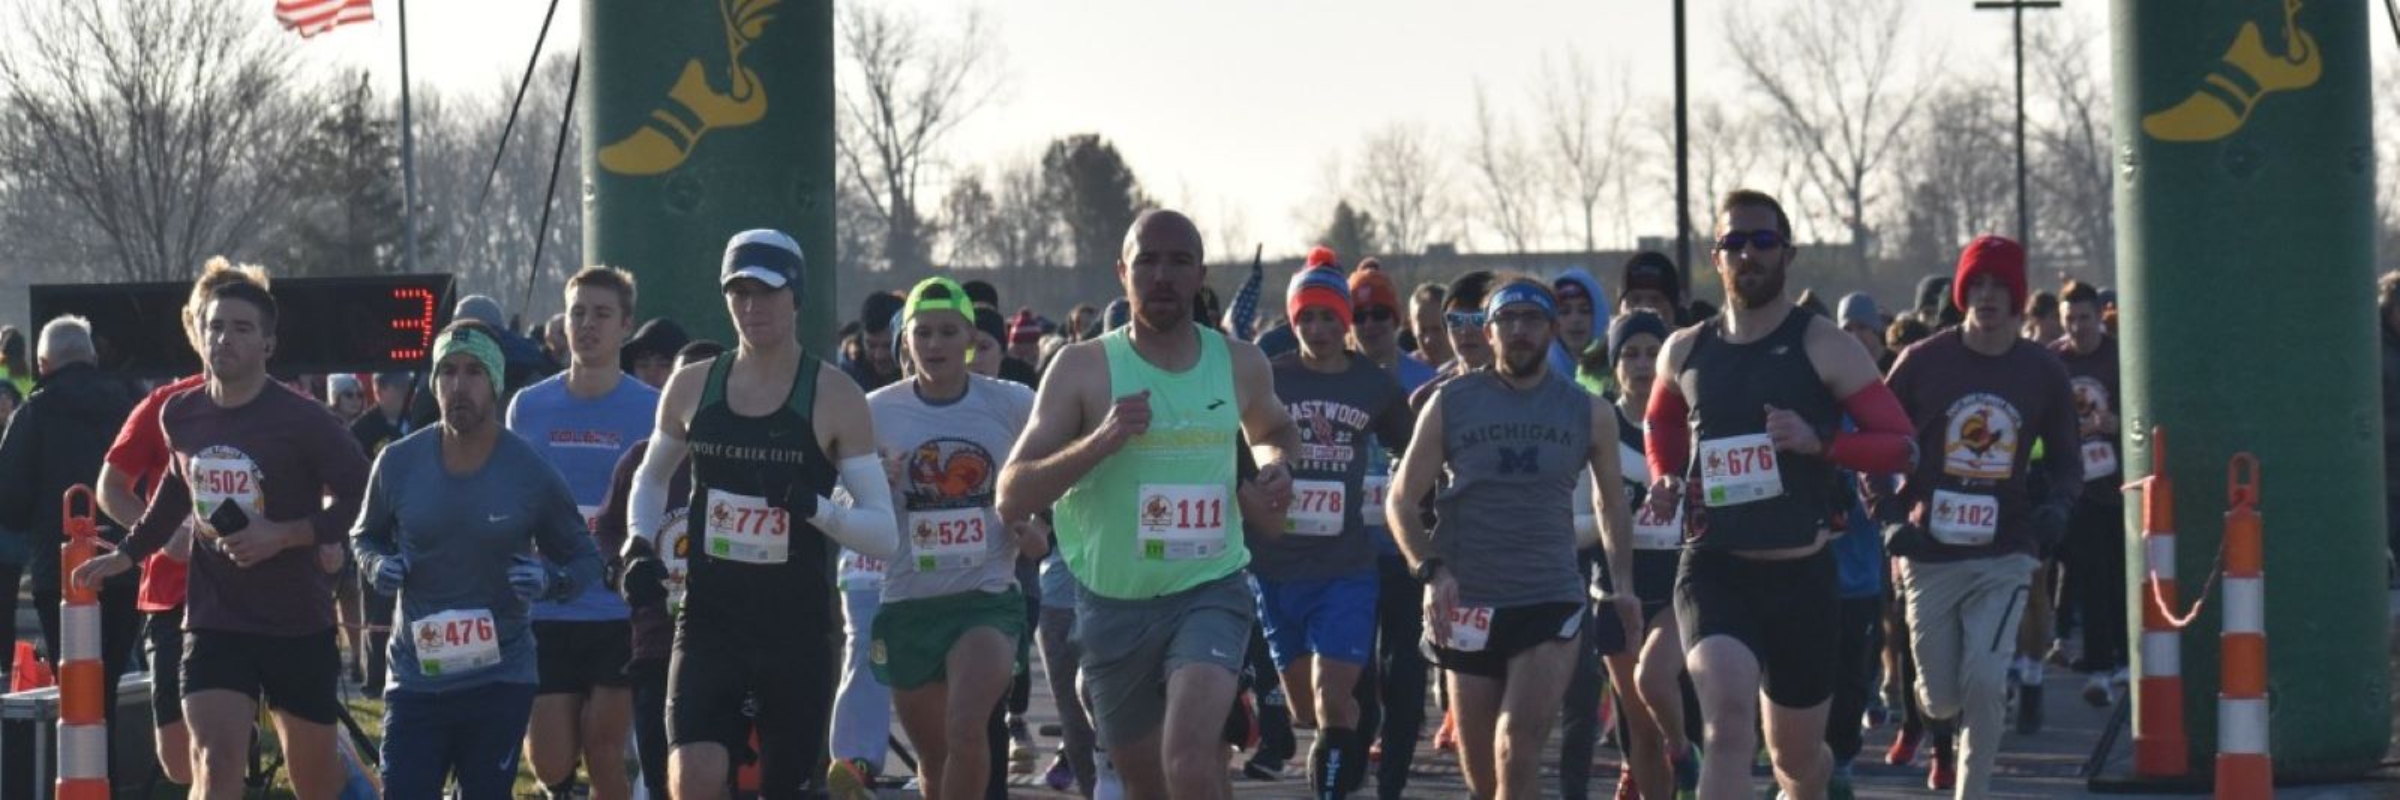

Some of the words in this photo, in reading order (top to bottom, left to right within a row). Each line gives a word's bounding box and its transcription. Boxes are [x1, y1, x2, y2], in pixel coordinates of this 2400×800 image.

[391, 288, 433, 358] 3
[1284, 400, 1370, 431] ASTWOOD
[1461, 423, 1573, 449] MICHIGAN
[725, 445, 767, 461] CREEK
[769, 448, 804, 464] ELITE
[1293, 460, 1347, 472] AGLES
[1499, 446, 1540, 474] M
[1727, 444, 1774, 477] 676
[208, 469, 250, 494] 502
[1177, 498, 1222, 529] 111
[1301, 489, 1342, 513] 778
[736, 507, 787, 536] 773
[1956, 505, 1994, 527] 102
[938, 518, 984, 546] 523
[444, 616, 493, 647] 476
